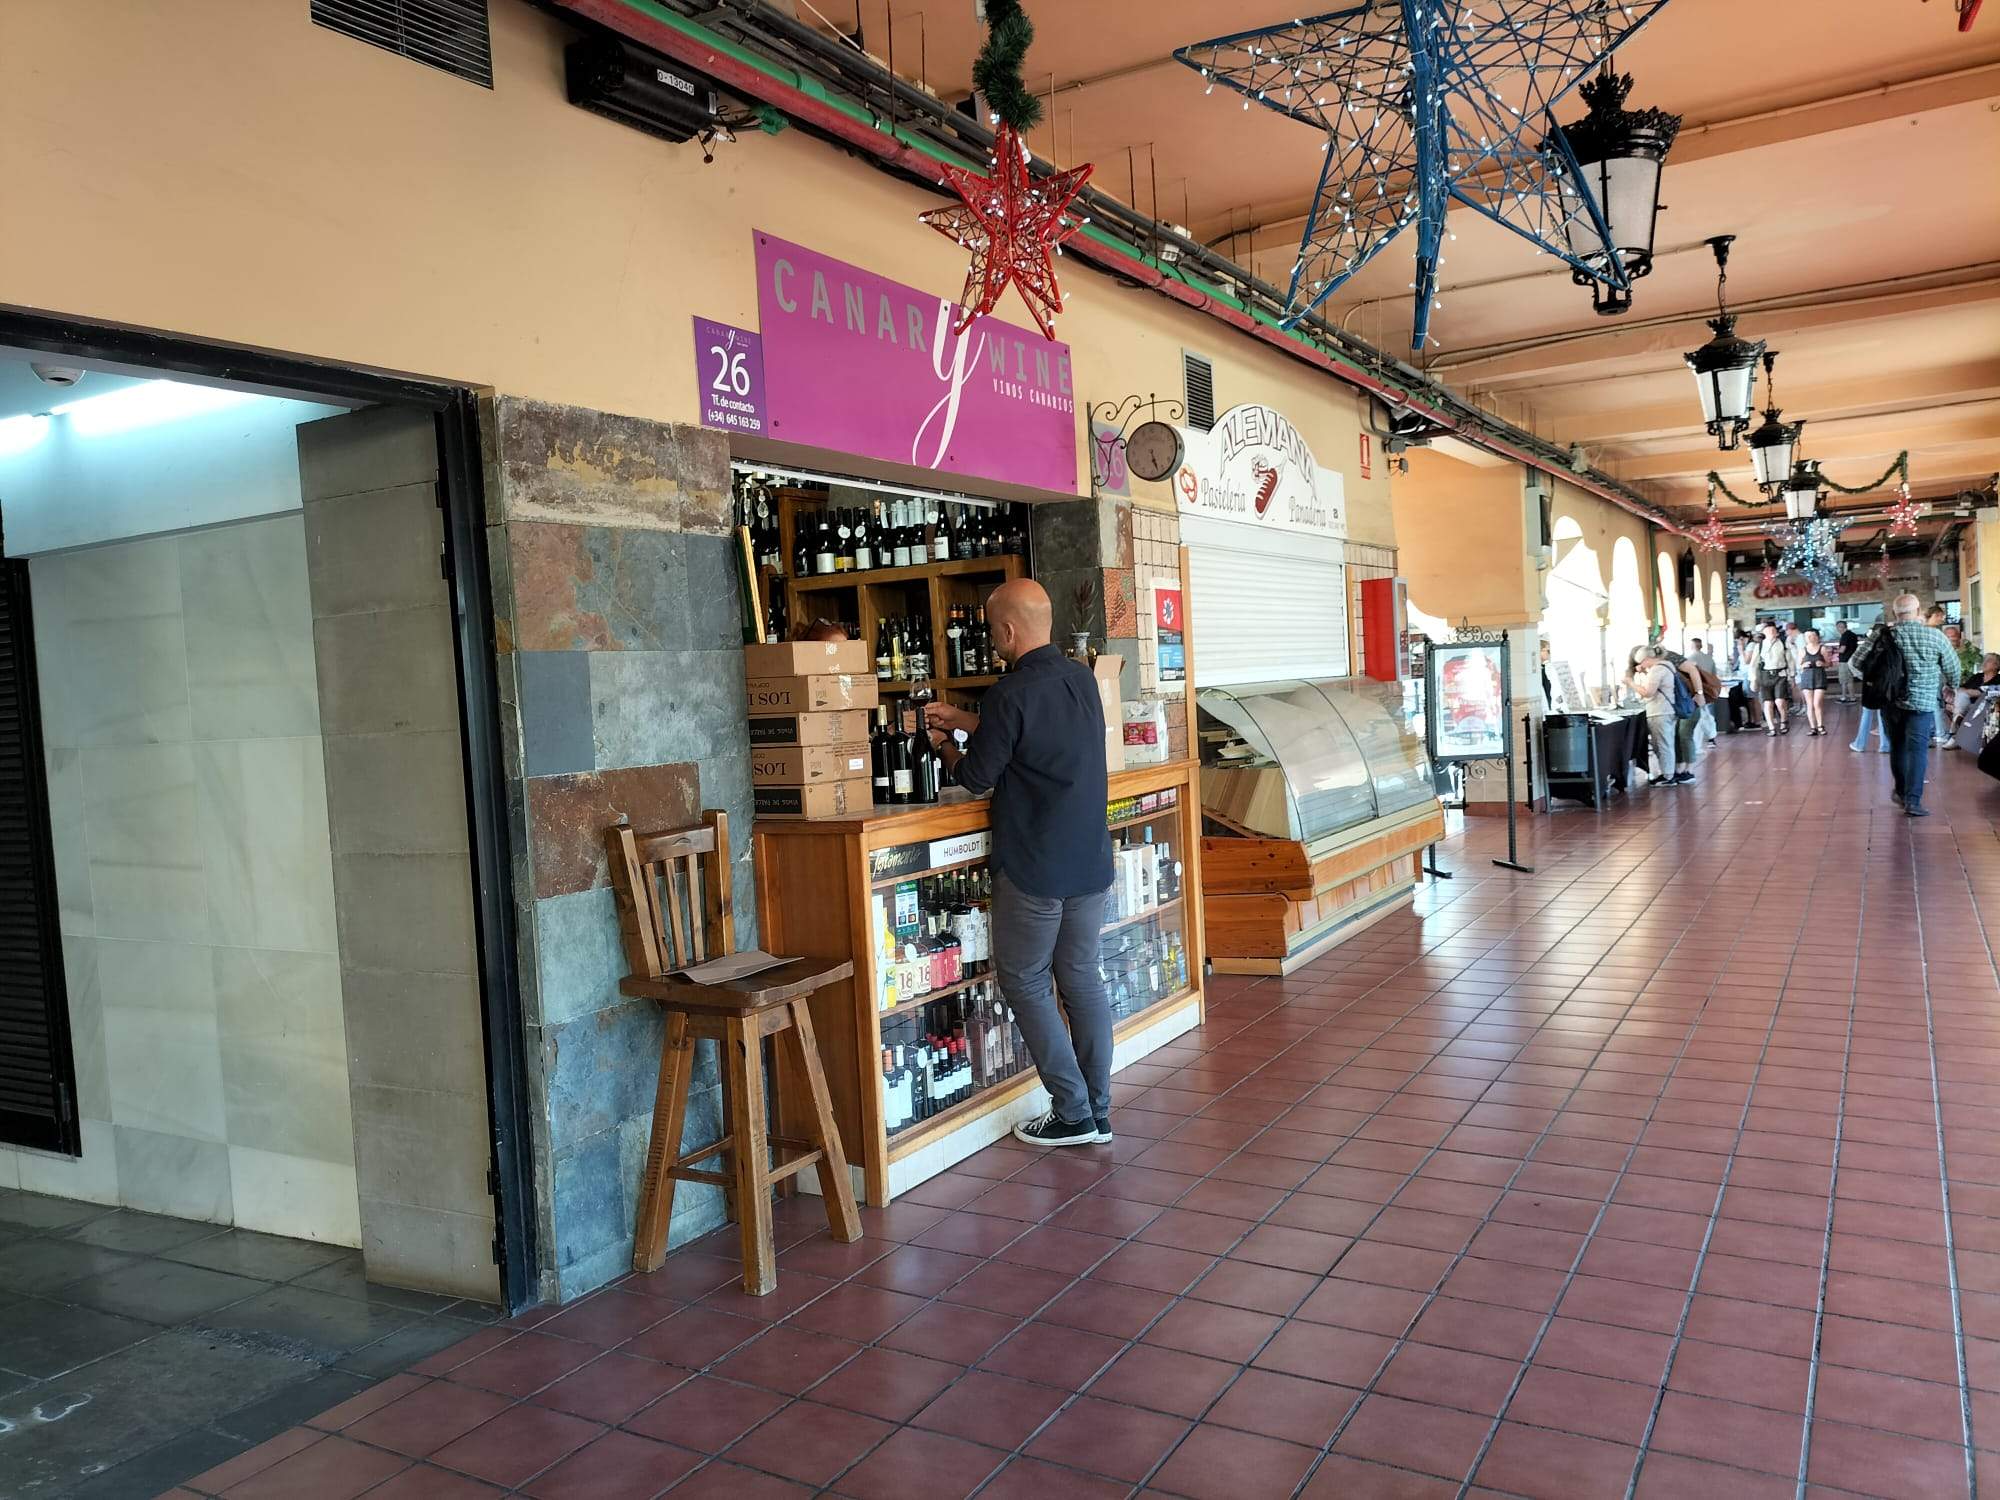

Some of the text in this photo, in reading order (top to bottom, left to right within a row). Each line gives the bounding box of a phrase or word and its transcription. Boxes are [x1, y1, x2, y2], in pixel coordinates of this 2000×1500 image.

[710, 345, 750, 396] 26
[987, 331, 1072, 396] WINE
[720, 395, 729, 408] de
[729, 400, 755, 414] contacto
[993, 378, 1073, 414] VINOS CANARIOS
[707, 408, 725, 425] (+34)
[1220, 405, 1318, 501] ALEMANA
[759, 691, 791, 706] LOS
[943, 840, 980, 858] HUMBOLDT
[901, 971, 913, 990] 18
